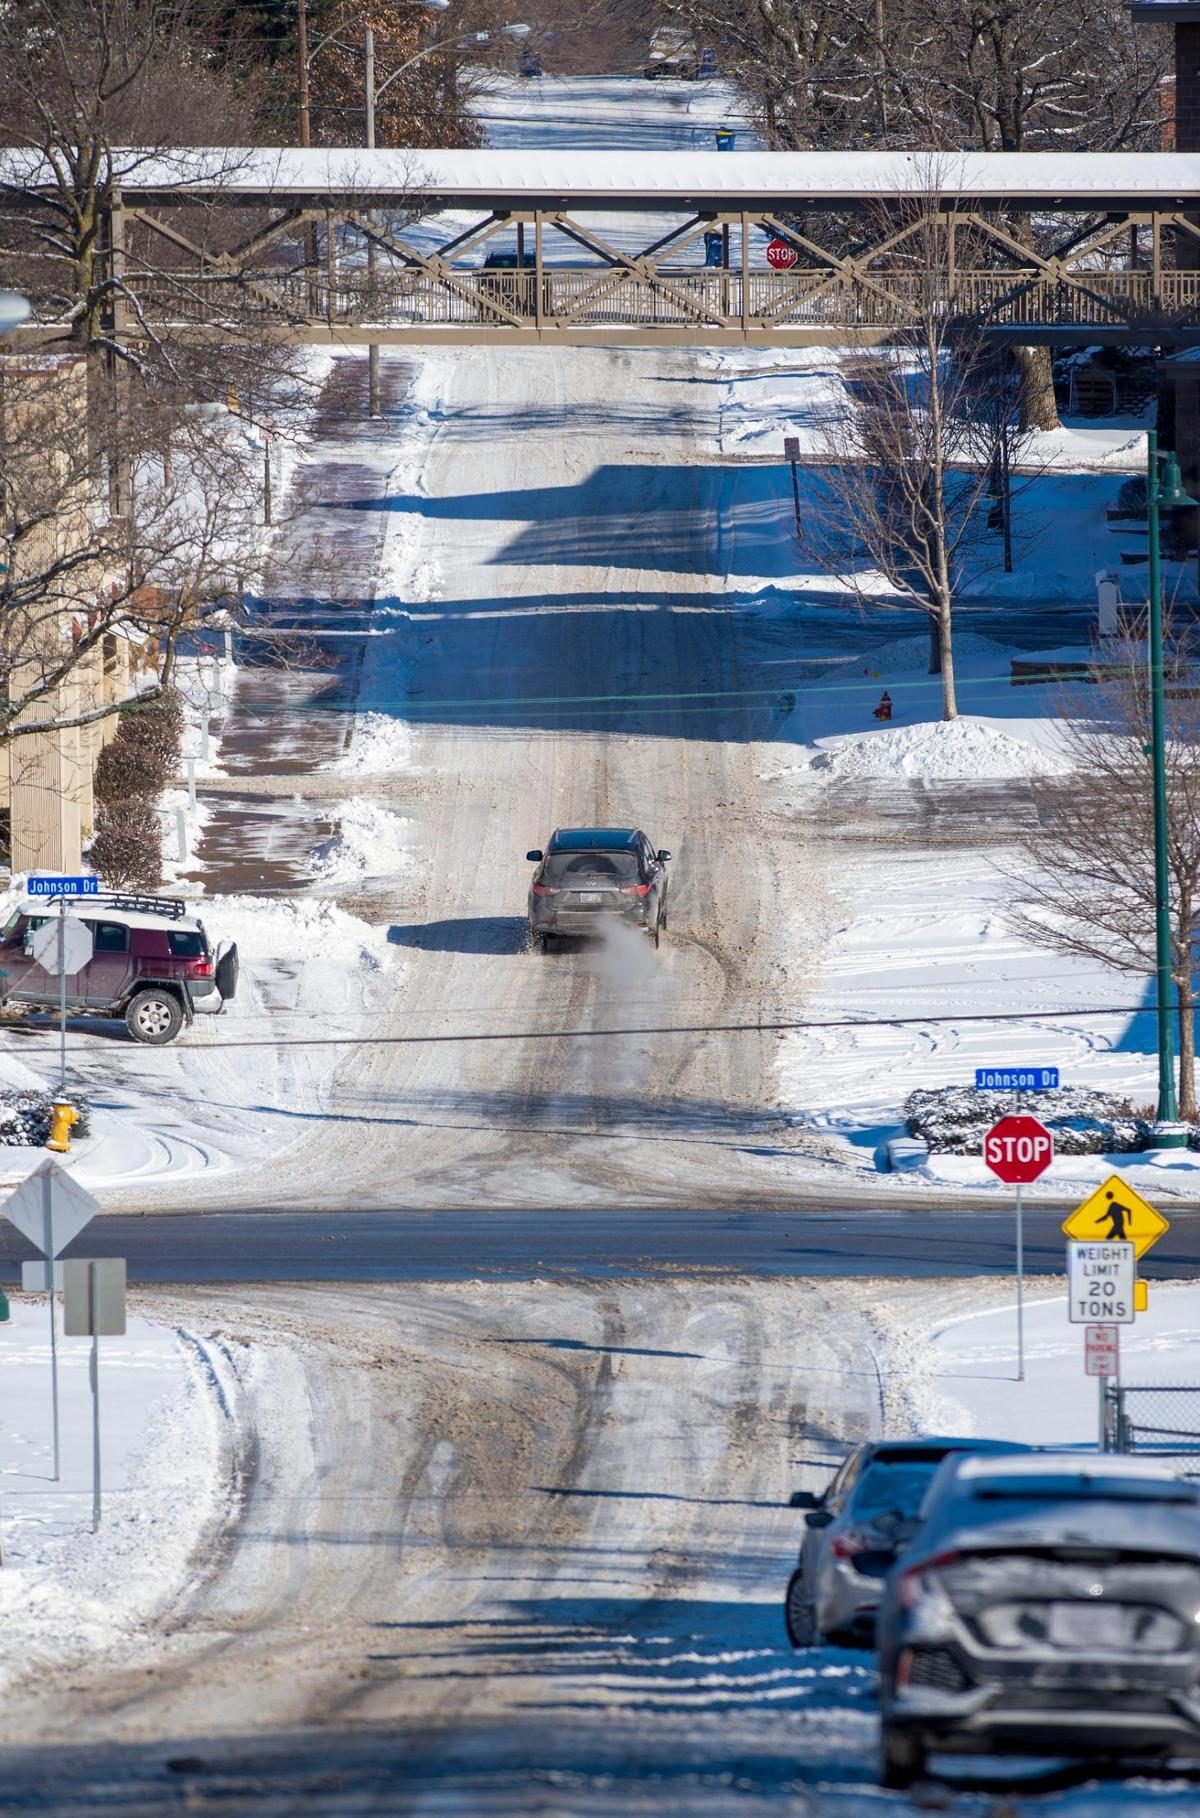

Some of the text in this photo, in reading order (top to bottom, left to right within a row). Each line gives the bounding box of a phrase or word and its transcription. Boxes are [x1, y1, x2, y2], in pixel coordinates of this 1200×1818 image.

[768, 248, 795, 260] STOP
[29, 879, 96, 893] Johnson Dr
[978, 1070, 1057, 1087] Johnson Dr
[987, 1136, 1049, 1164] STOP
[1077, 1248, 1129, 1260] WEIGHT
[1083, 1264, 1120, 1277] LIMIT
[1089, 1281, 1116, 1297] 20
[1079, 1301, 1126, 1317] TONS
